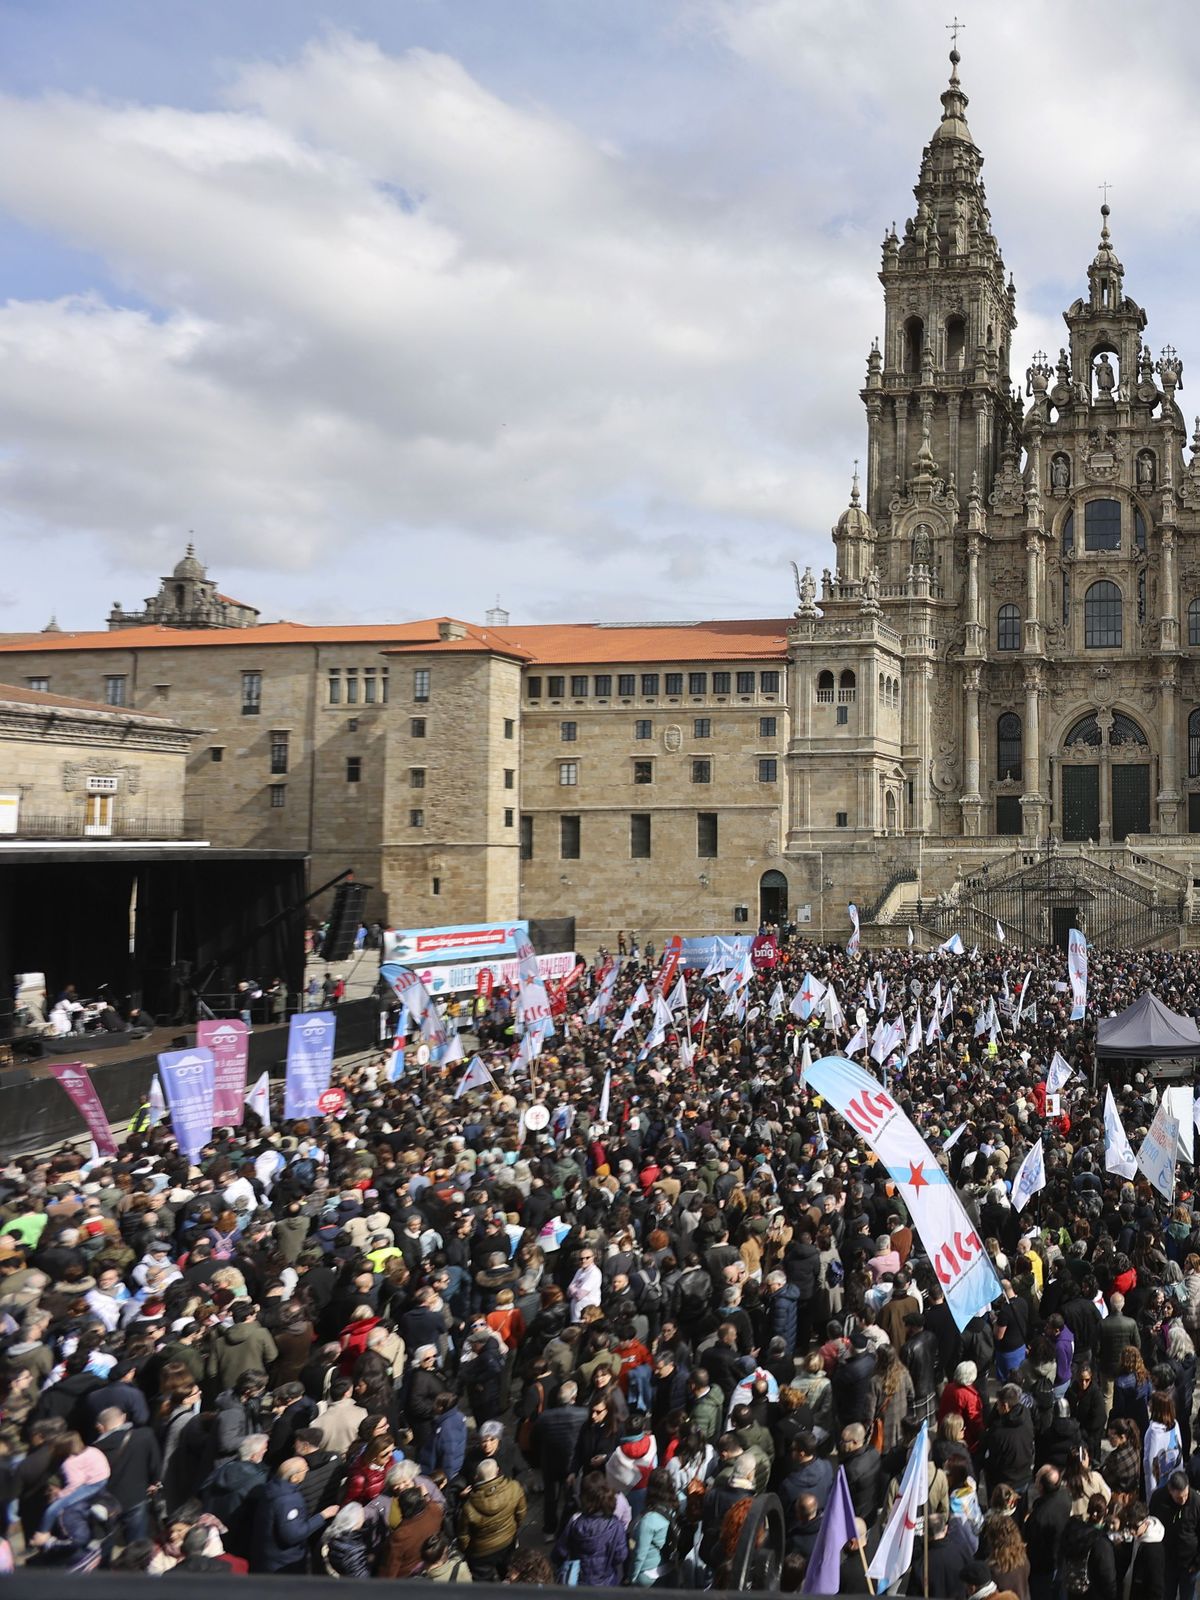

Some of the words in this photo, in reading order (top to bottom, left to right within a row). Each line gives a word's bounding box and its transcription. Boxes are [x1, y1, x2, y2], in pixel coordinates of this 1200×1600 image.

[754, 948, 774, 958] bng
[845, 1090, 894, 1134] CIG
[935, 1231, 983, 1284] CIG
